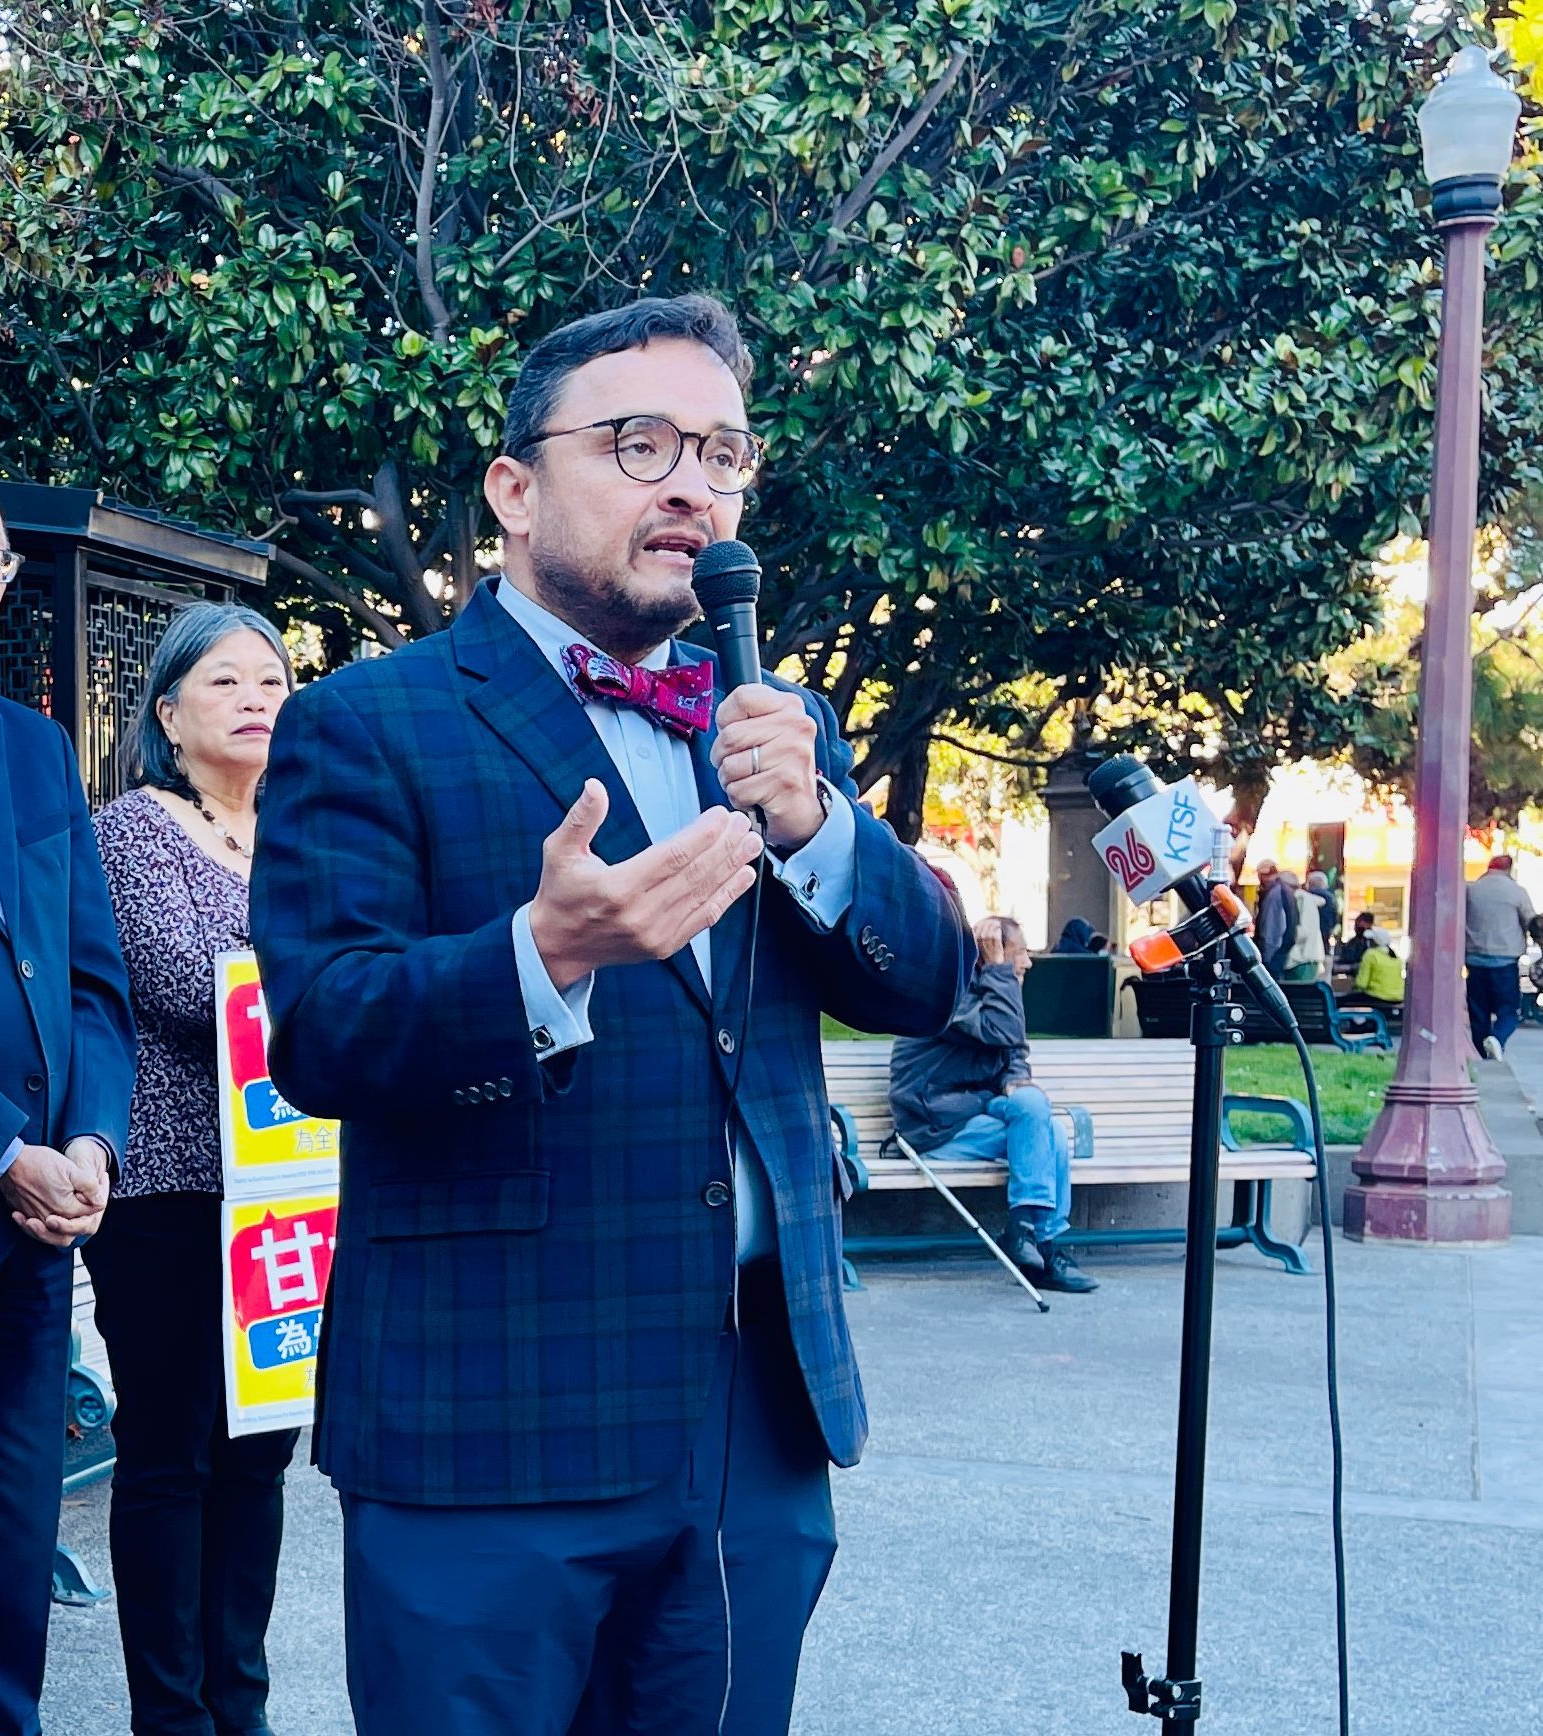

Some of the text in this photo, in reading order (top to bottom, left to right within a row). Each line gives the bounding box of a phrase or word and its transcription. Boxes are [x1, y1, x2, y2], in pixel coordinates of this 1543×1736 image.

[1105, 827, 1156, 893] 26
[1163, 790, 1198, 863] KTSF
[295, 1126, 340, 1153] 為全
[250, 1220, 336, 1311] 甘
